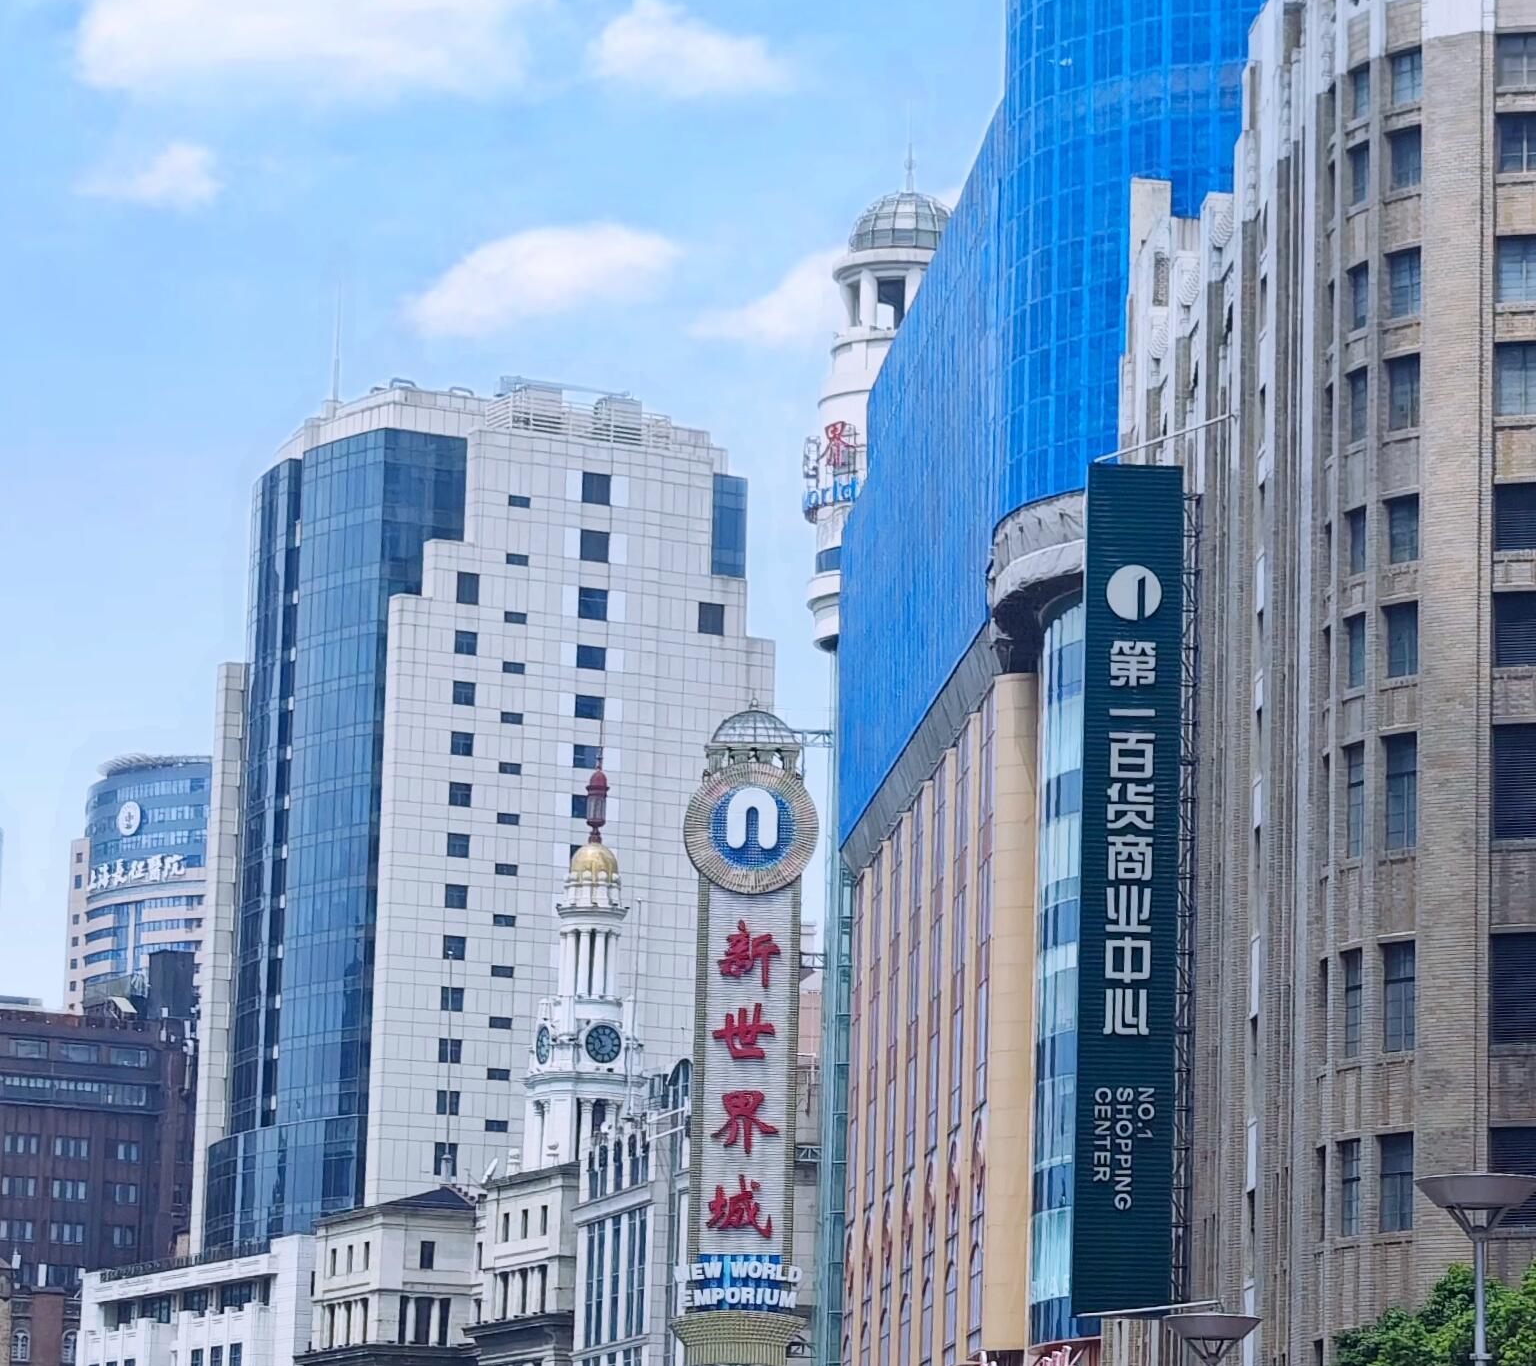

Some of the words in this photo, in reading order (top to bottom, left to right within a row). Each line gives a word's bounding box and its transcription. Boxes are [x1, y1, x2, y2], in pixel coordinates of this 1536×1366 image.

[1103, 640, 1156, 1036] 第一百货商业中心
[706, 921, 781, 1237] 新世界城
[1136, 1087, 1156, 1139] NO.1
[1092, 1086, 1113, 1182] CENTER
[1114, 1086, 1134, 1211] SHOPPING
[674, 1261, 723, 1283] NEW
[729, 1261, 803, 1283] WORLD
[681, 1286, 798, 1309] EMPORIUM
